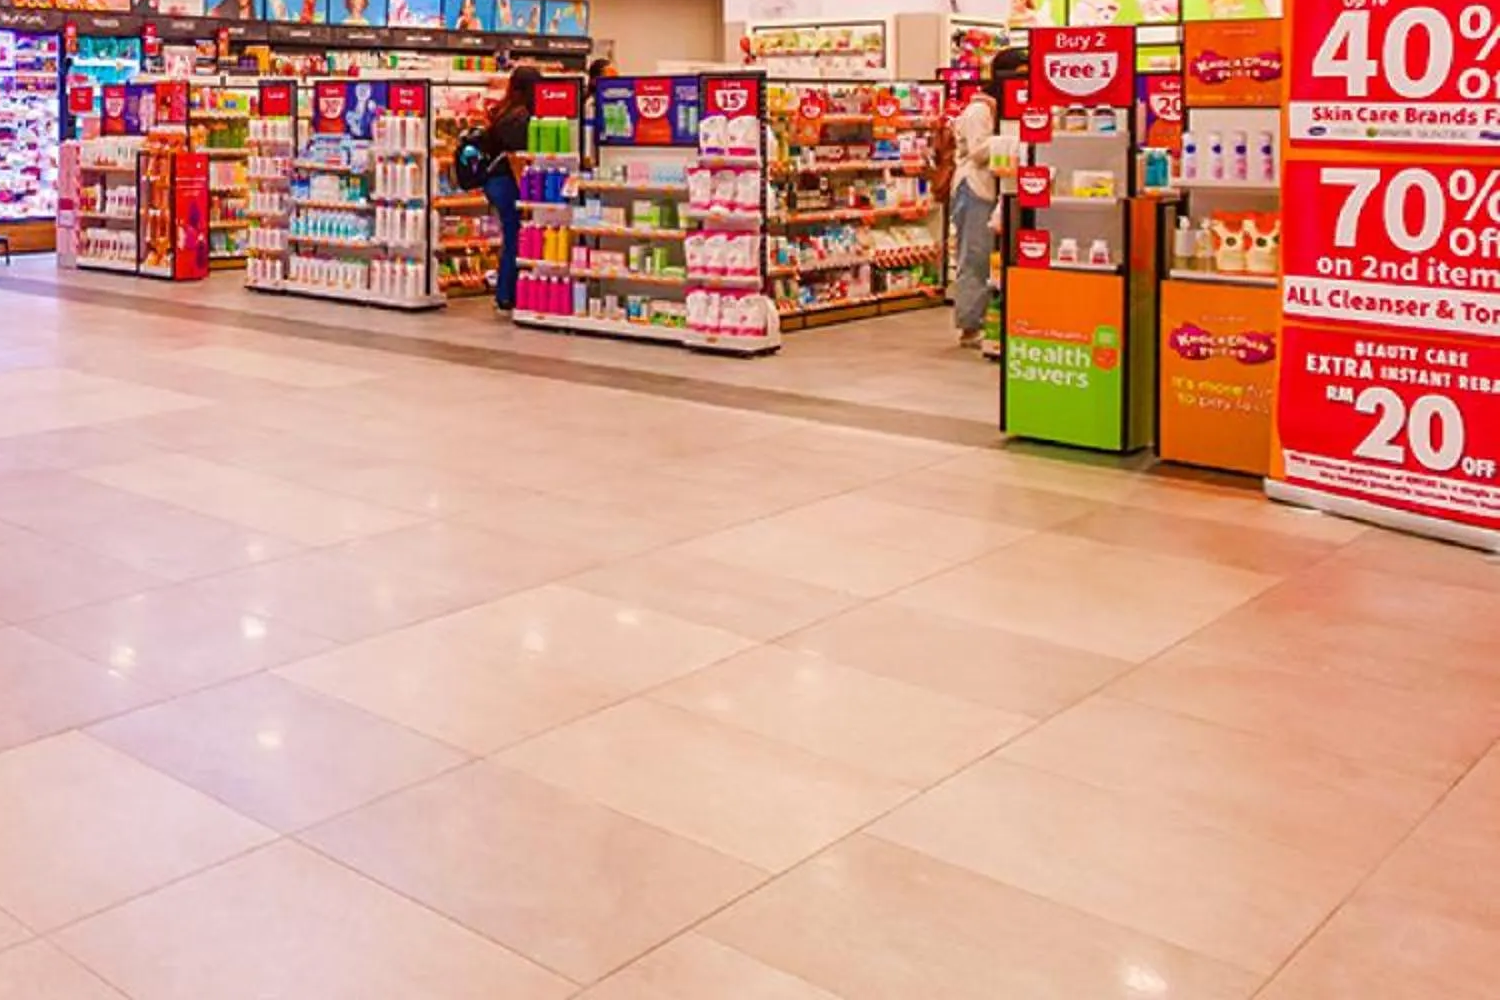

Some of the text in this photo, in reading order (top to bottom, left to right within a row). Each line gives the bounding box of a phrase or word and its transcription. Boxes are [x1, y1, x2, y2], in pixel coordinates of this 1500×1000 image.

[1056, 32, 1107, 51] Buy 2
[1049, 60, 1111, 78] Free 1
[1312, 105, 1351, 123] Skin
[1357, 107, 1399, 124] Care
[1405, 107, 1478, 126] Brands
[1320, 167, 1500, 253] 70%
[1449, 227, 1500, 258] Of
[1316, 255, 1500, 289] on 2nd item
[1287, 285, 1322, 307] ALL
[1327, 290, 1431, 318] Cleanser
[1436, 300, 1454, 320] &
[1009, 341, 1092, 369] Health
[1354, 340, 1469, 368] BEAUTY CARE
[1008, 359, 1089, 389] Savers
[1305, 353, 1374, 380] EXTRA
[1380, 365, 1452, 389] INSTANT
[1325, 384, 1497, 479] RM 20 OFF
